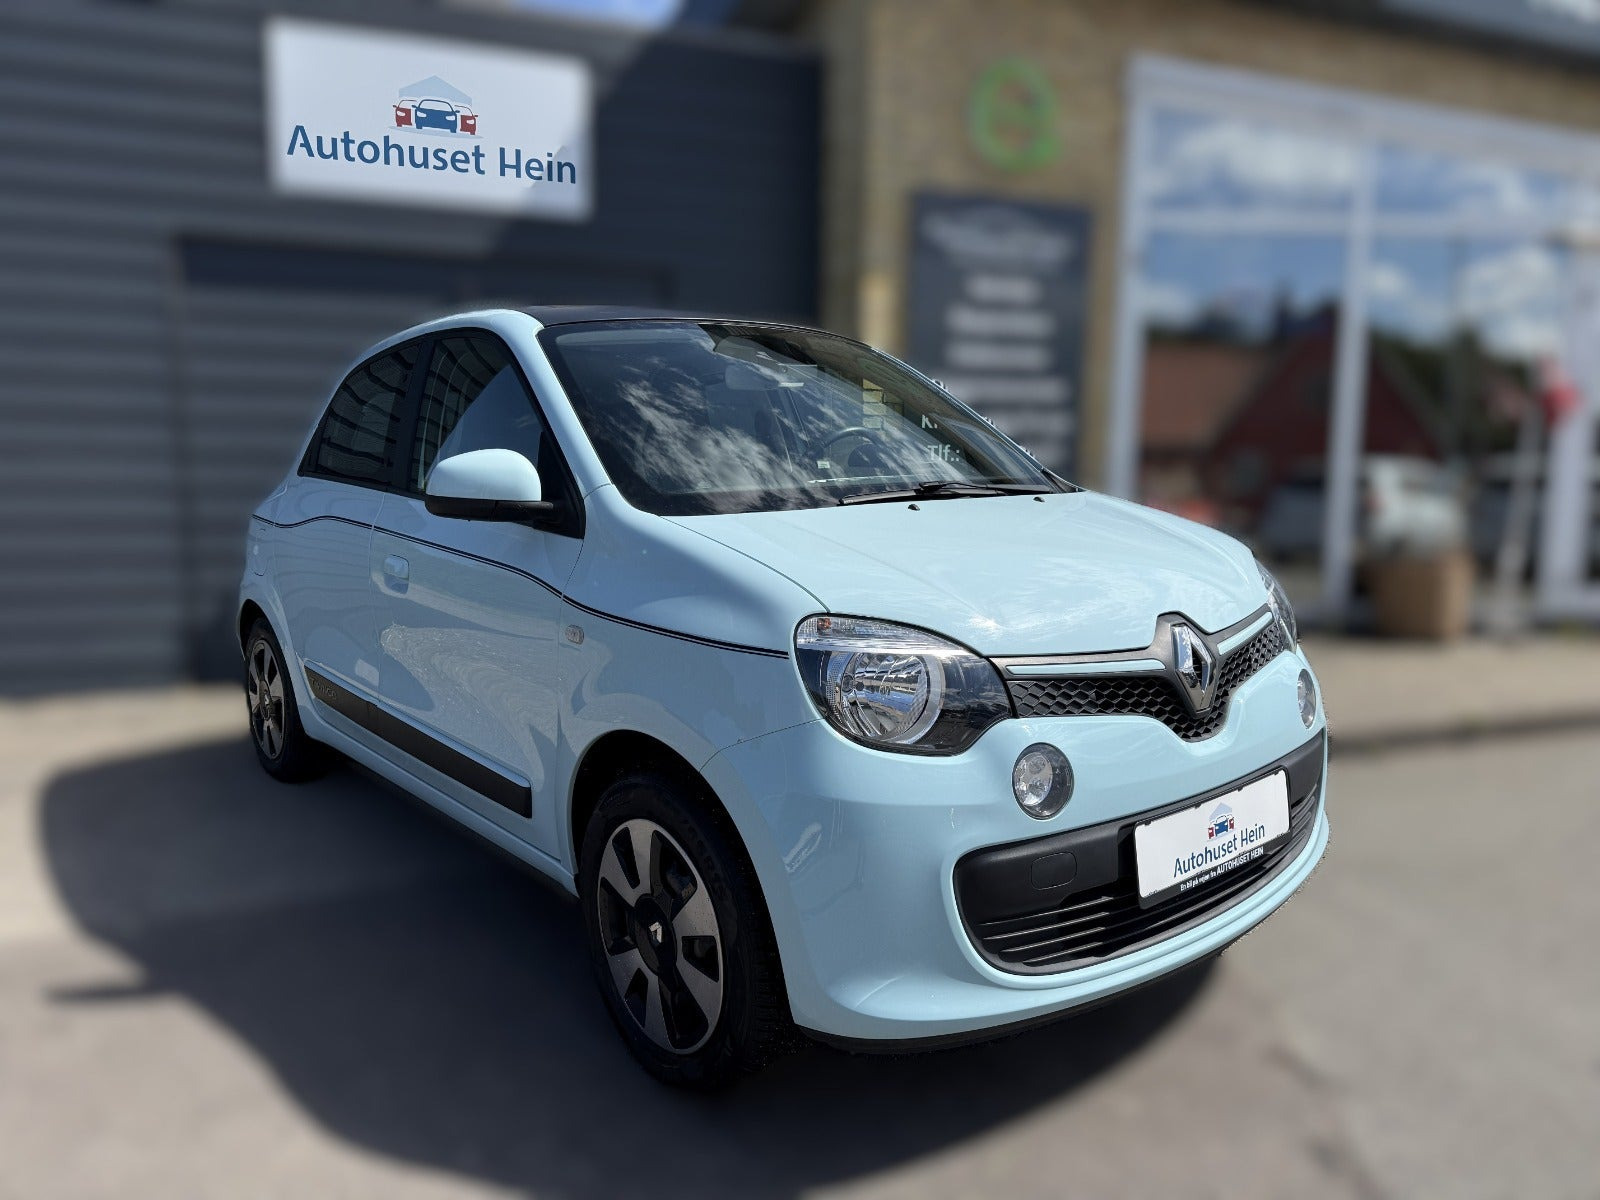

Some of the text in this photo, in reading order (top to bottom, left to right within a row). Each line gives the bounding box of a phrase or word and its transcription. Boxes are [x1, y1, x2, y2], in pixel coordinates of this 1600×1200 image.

[287, 124, 577, 184] Autohuset Hein
[927, 444, 960, 462] Tlf.:
[1173, 823, 1265, 878] Autohuset Hein
[1180, 883, 1187, 891] En
[1192, 876, 1199, 888] på
[1216, 852, 1251, 876] AUTOHUSET
[1250, 845, 1264, 860] HEIN
